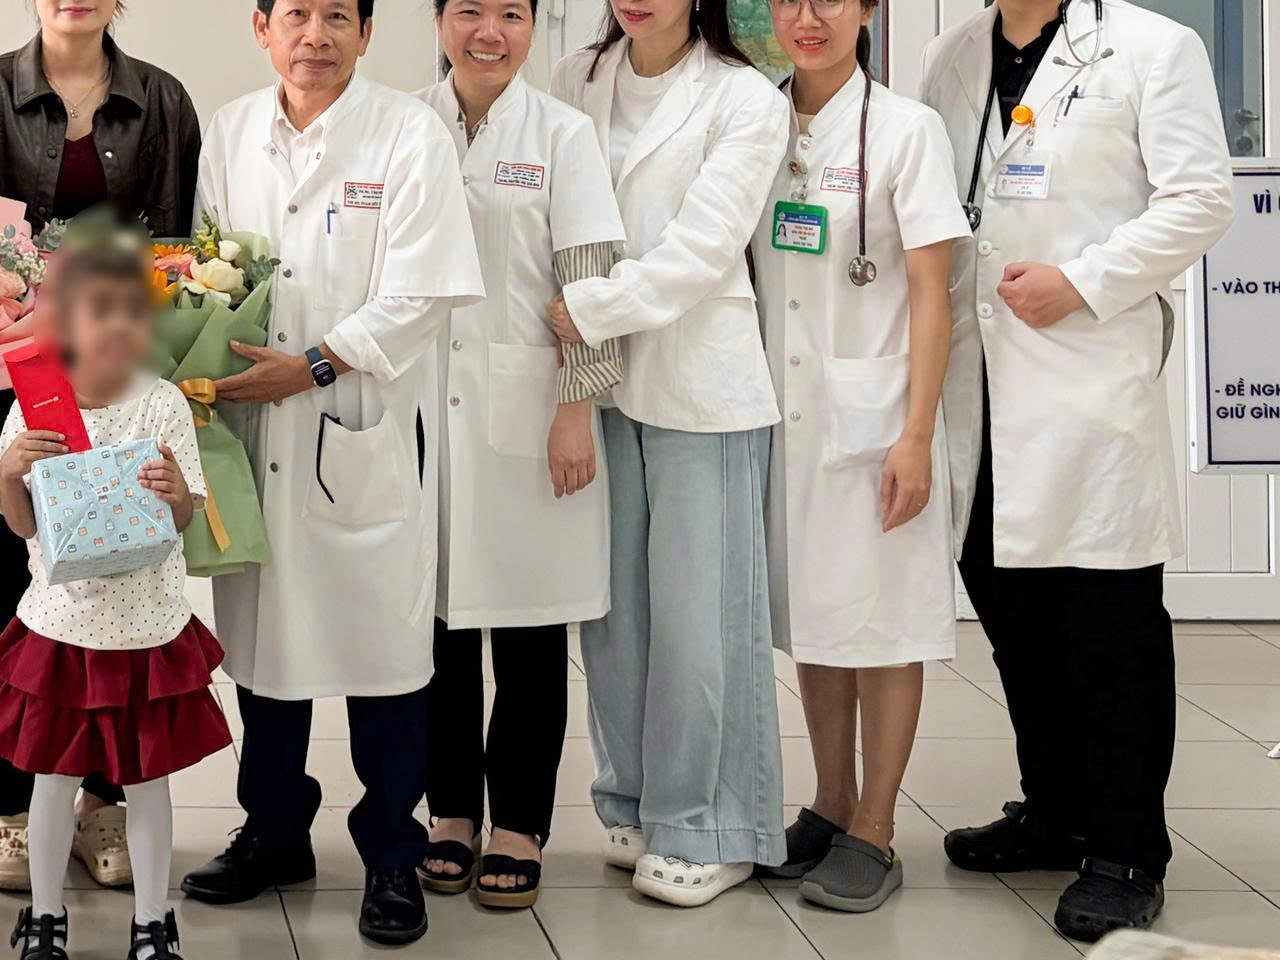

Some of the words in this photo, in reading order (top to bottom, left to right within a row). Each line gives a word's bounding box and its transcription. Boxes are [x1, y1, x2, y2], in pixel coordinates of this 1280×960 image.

[1253, 189, 1271, 213] VÌ
[1222, 277, 1258, 294] VÀO
[1225, 377, 1245, 396] ĐỀ
[1216, 403, 1246, 419] GIỮ
